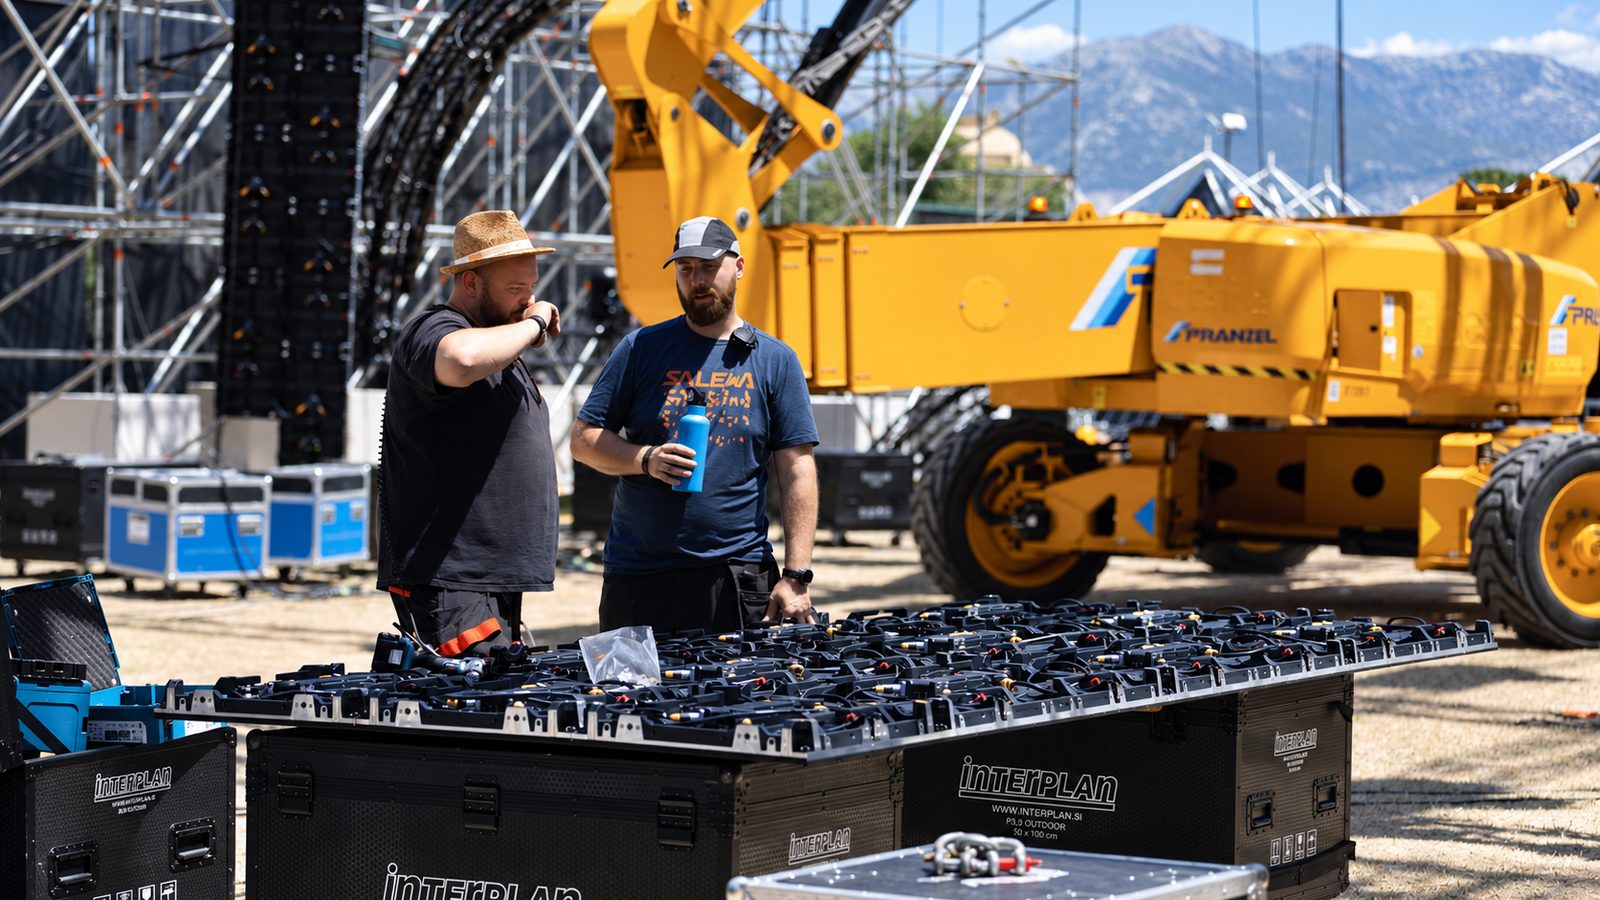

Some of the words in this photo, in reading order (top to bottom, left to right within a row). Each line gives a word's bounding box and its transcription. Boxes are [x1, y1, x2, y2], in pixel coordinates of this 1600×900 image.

[662, 370, 755, 389] SALEWA
[991, 804, 1083, 822] WWW.INTERPLAN.SI
[1024, 820, 1066, 831] OUTDOOR
[1031, 830, 1045, 839] 100
